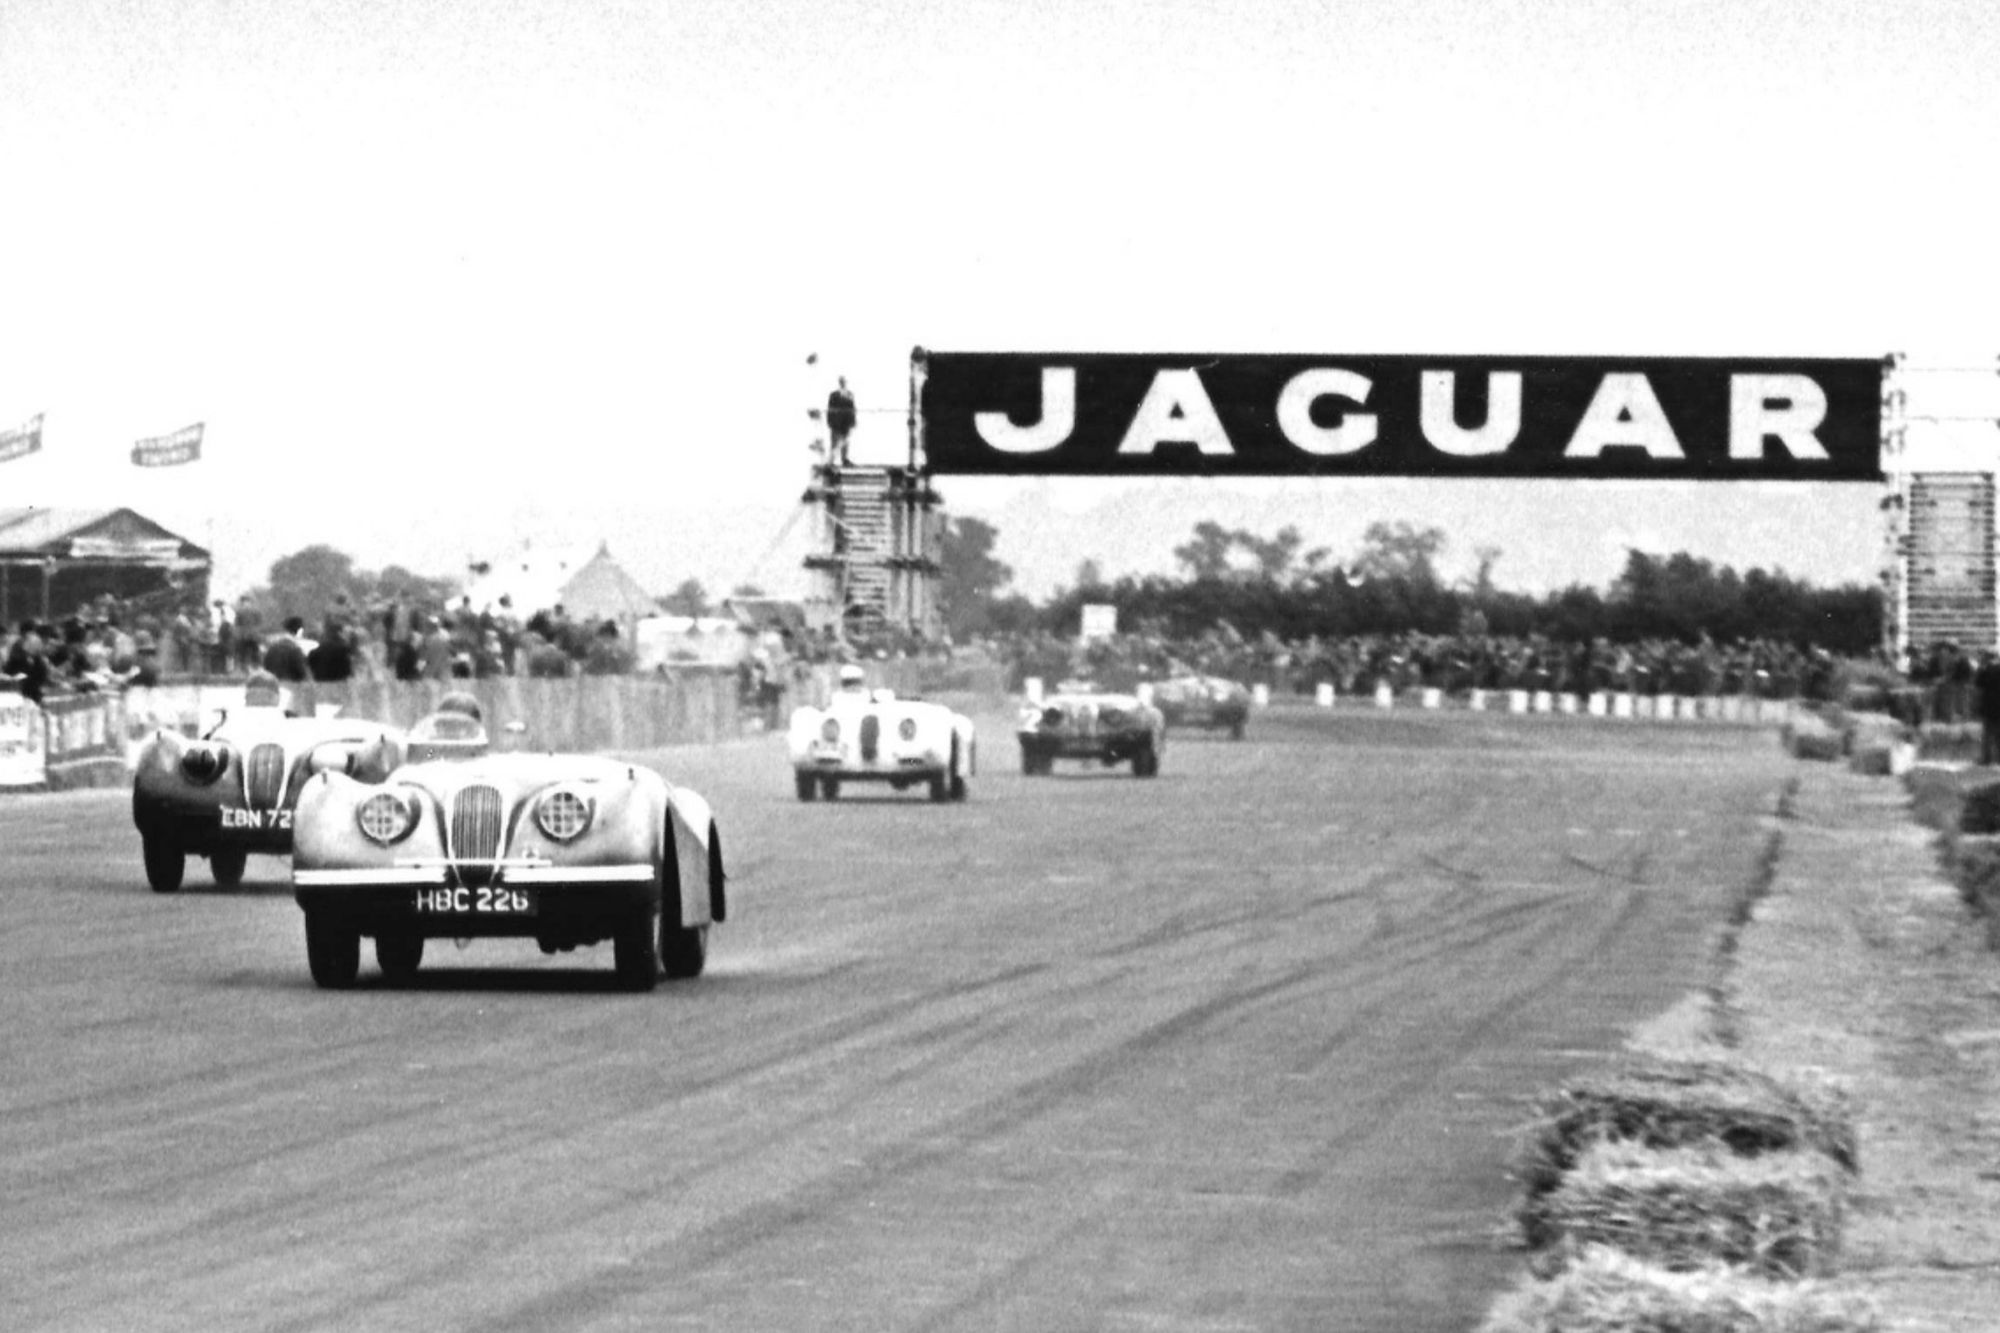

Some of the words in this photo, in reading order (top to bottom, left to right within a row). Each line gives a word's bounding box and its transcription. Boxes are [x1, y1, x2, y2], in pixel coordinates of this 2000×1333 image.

[974, 366, 1830, 461] JAGUAR
[221, 807, 262, 829] EBN
[265, 808, 298, 829] 72
[417, 886, 470, 912] HBC
[475, 886, 529, 912] 226
